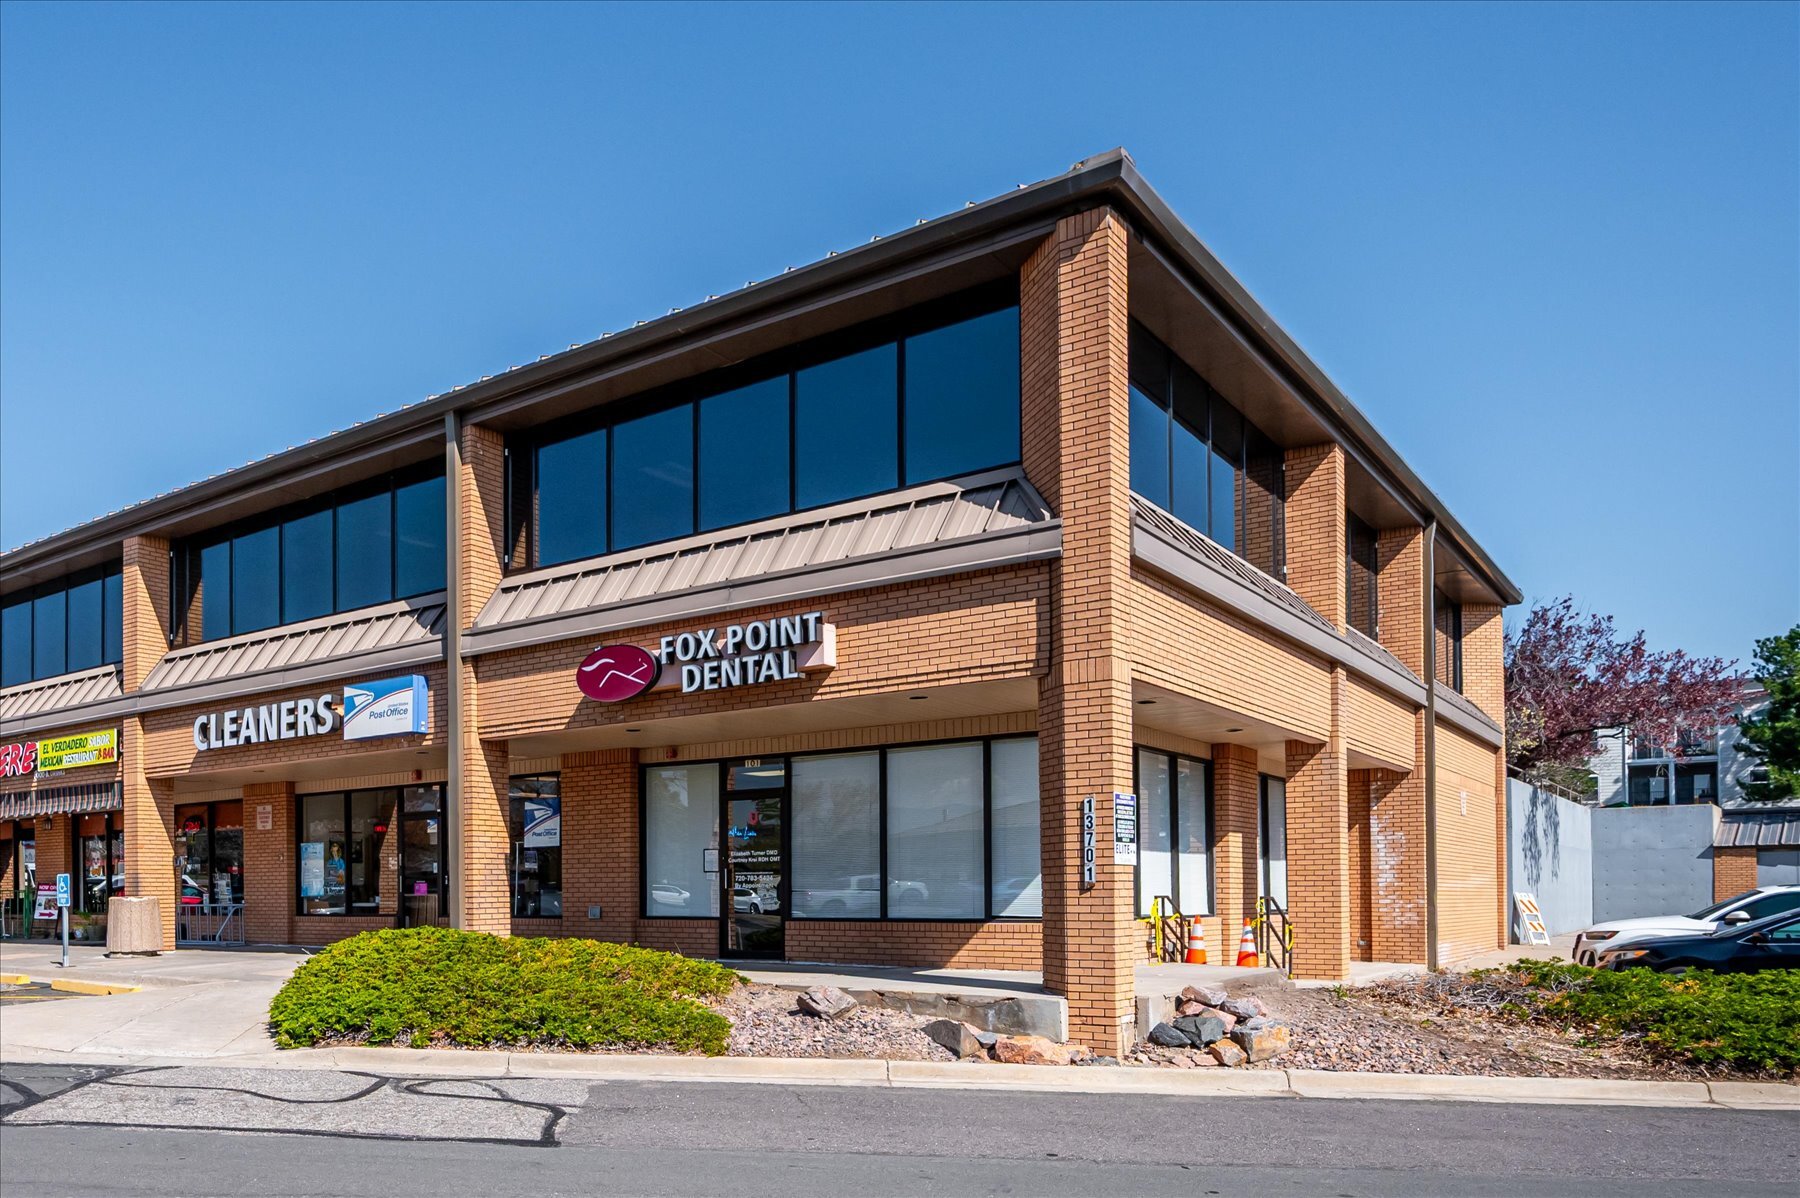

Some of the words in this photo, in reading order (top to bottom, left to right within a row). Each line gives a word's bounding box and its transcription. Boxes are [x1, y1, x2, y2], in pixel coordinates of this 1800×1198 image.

[660, 628, 716, 665] FOX
[726, 611, 823, 655] POINT
[681, 650, 799, 694] DENTAL
[193, 693, 334, 751] CLEANERS
[369, 709, 385, 720] Post
[386, 707, 408, 718] Office
[40, 756, 63, 768] MEXICAN
[102, 746, 115, 759] BAR
[42, 744, 49, 754] EL
[51, 737, 88, 753] VERDADERO
